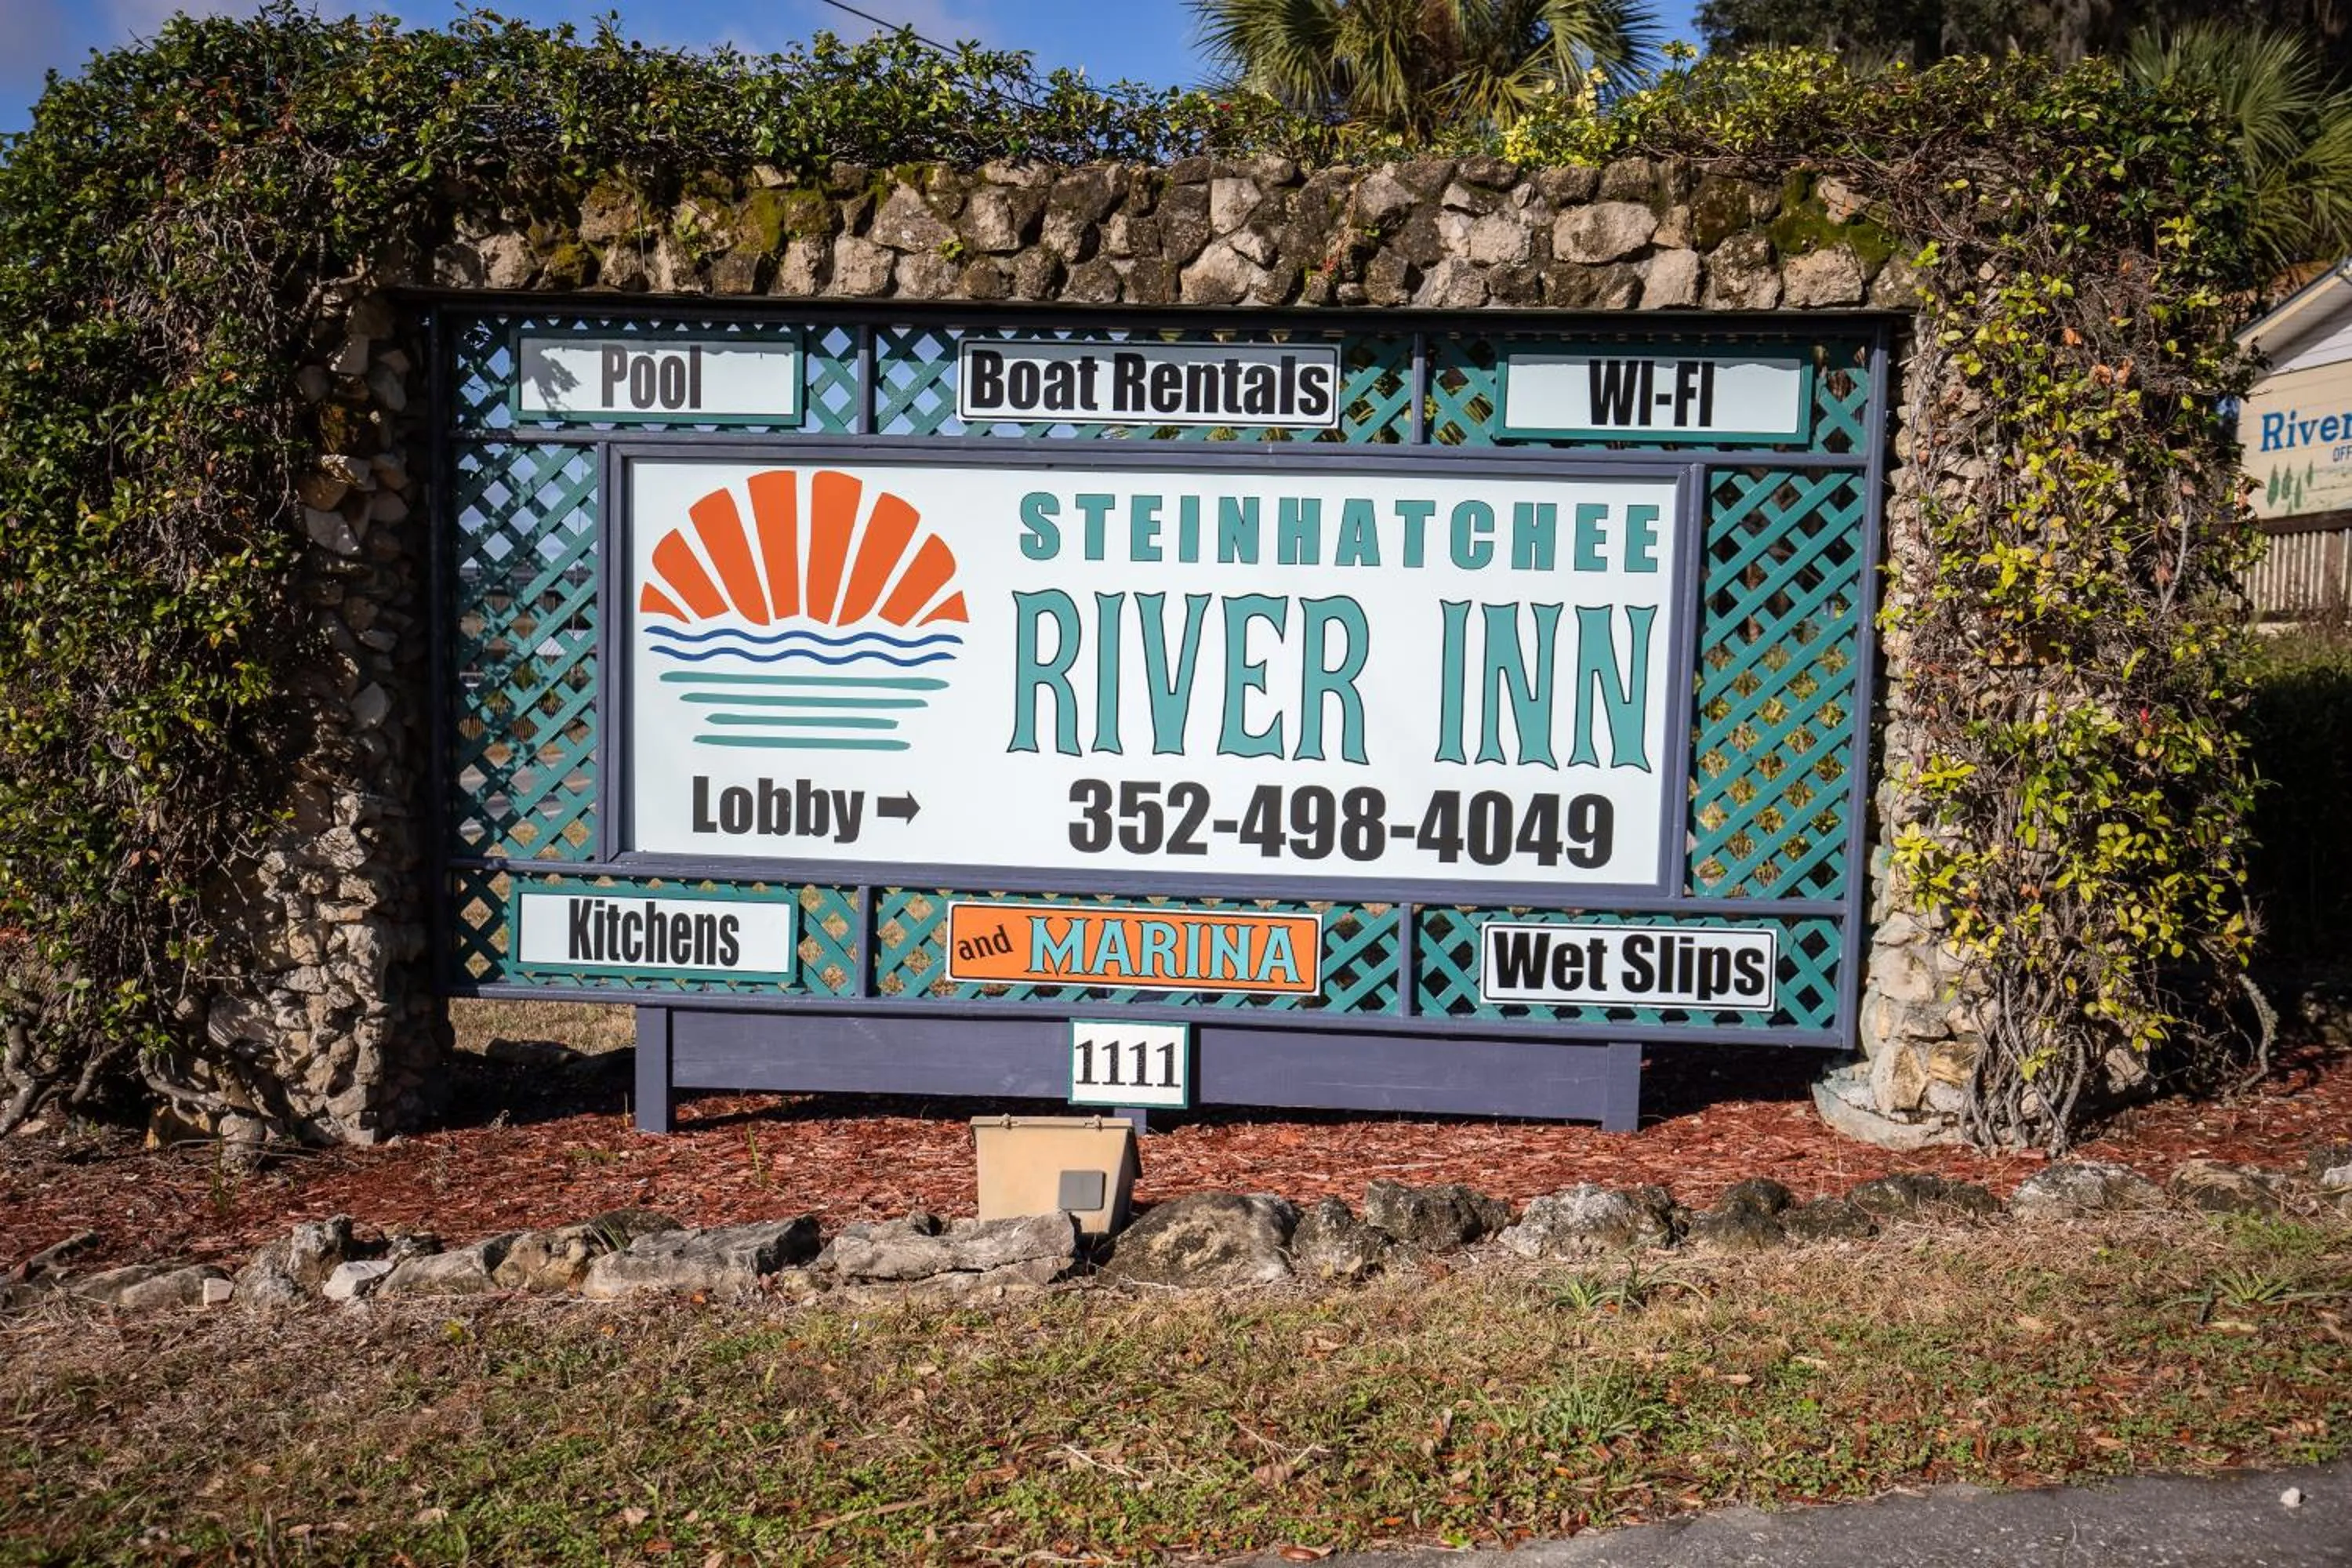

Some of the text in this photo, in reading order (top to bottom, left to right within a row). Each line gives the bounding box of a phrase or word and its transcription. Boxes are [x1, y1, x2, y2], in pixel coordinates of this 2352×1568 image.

[601, 342, 702, 411] Pool
[969, 350, 1330, 417] Boat Rentals
[1589, 359, 1715, 428] WI-FI
[1018, 491, 1661, 574] STEINHATCHEE
[1006, 587, 1658, 773] RIVER INN
[692, 775, 865, 844] Lobby
[1068, 778, 1615, 870] 352-498-4049
[568, 898, 740, 967] Kitchens
[957, 914, 1305, 984] and MARINA
[1493, 931, 1765, 1001] Wet Slips
[1075, 1039, 1181, 1088] 1111
